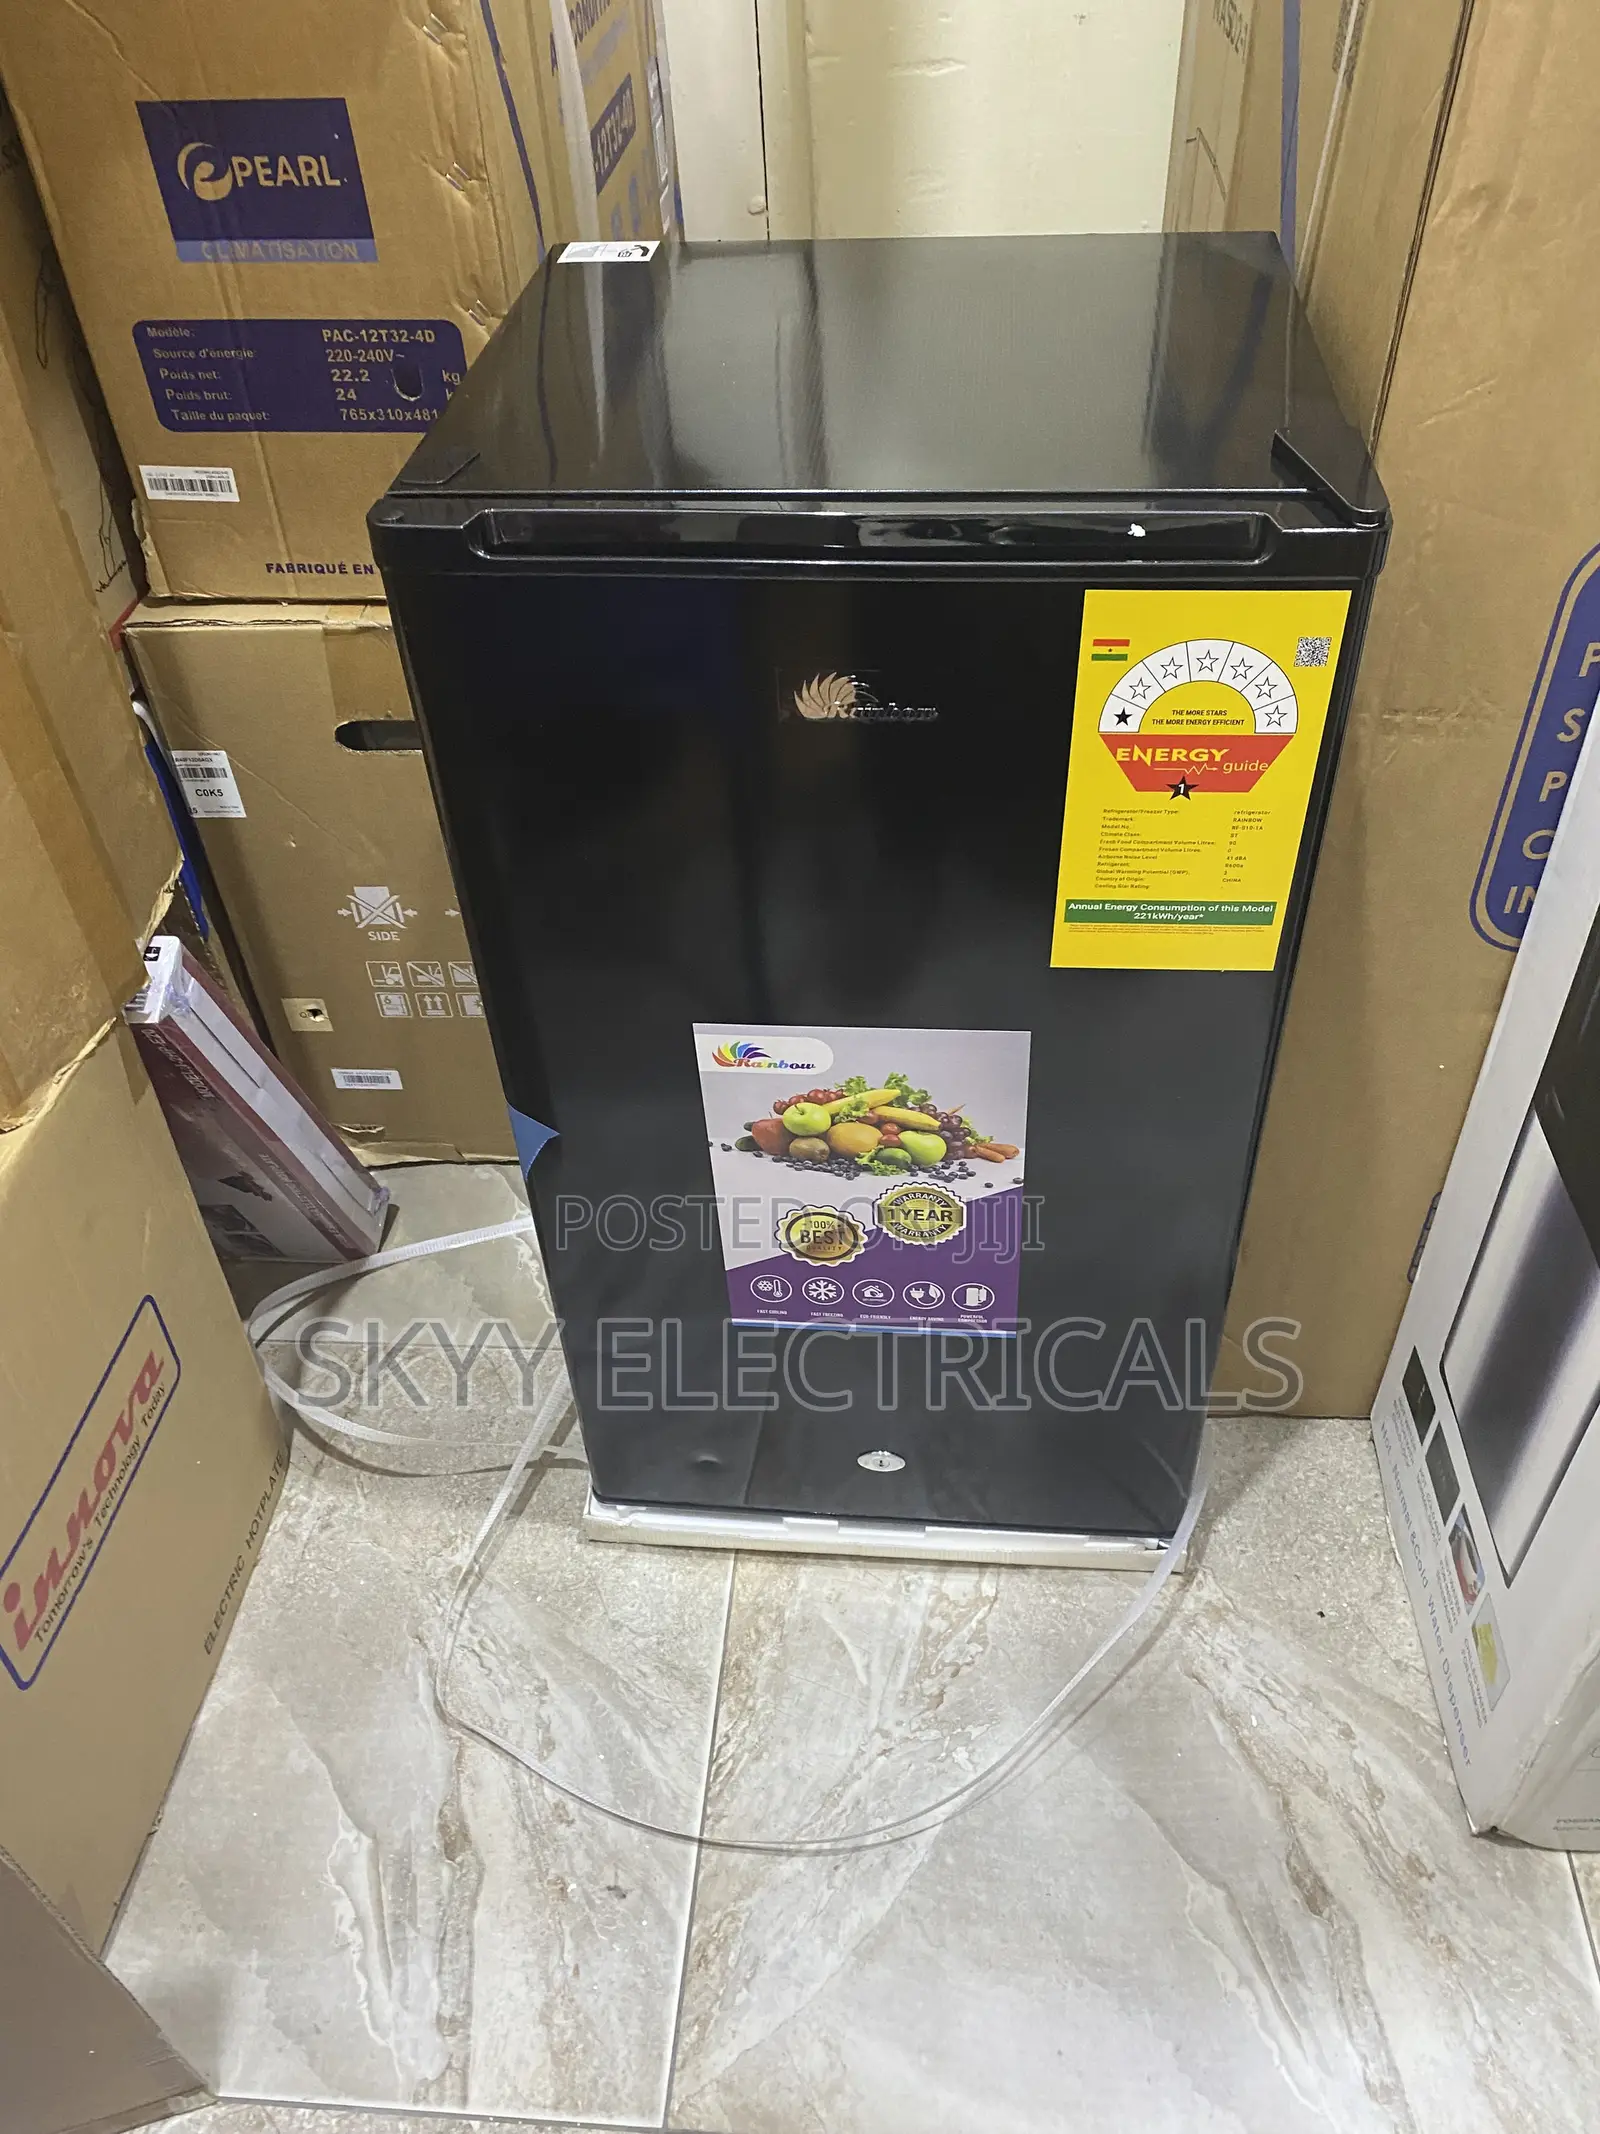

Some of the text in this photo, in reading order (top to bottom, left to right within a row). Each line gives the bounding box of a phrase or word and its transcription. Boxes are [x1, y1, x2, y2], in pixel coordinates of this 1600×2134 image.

[231, 154, 341, 188] PEARL
[322, 328, 435, 344] PAC-12T32-4D
[153, 348, 196, 359] Source
[159, 368, 461, 385] Poids net: 22.2 kg
[165, 388, 202, 400] Poids
[204, 389, 232, 401] brut:
[335, 388, 357, 401] 24
[171, 408, 208, 420] Taille
[209, 408, 225, 420] du
[227, 409, 271, 423] paquet:
[265, 561, 374, 575] FABRIQUÉ EN
[1115, 744, 1230, 766] ENERGY
[1222, 760, 1269, 774] guide
[1104, 903, 1138, 912] Energy
[1140, 904, 1207, 912] Consumption
[1208, 904, 1219, 912] of
[1221, 904, 1240, 912] this
[367, 931, 401, 942] SIDE
[733, 1058, 816, 1070] Rainbow
[893, 1192, 948, 1207] WARRANTY
[900, 1209, 953, 1222] YEAR
[893, 1222, 948, 1238] WARRANTY
[800, 1230, 849, 1246] BEST
[2, 1350, 166, 1652] innova
[35, 1381, 168, 1643] Tomorrow's Technology Today
[203, 1449, 286, 1656] ELECTRIC HOTPLATE
[1428, 1594, 1445, 1655] Water
[1442, 1656, 1472, 1769] Dispenser
